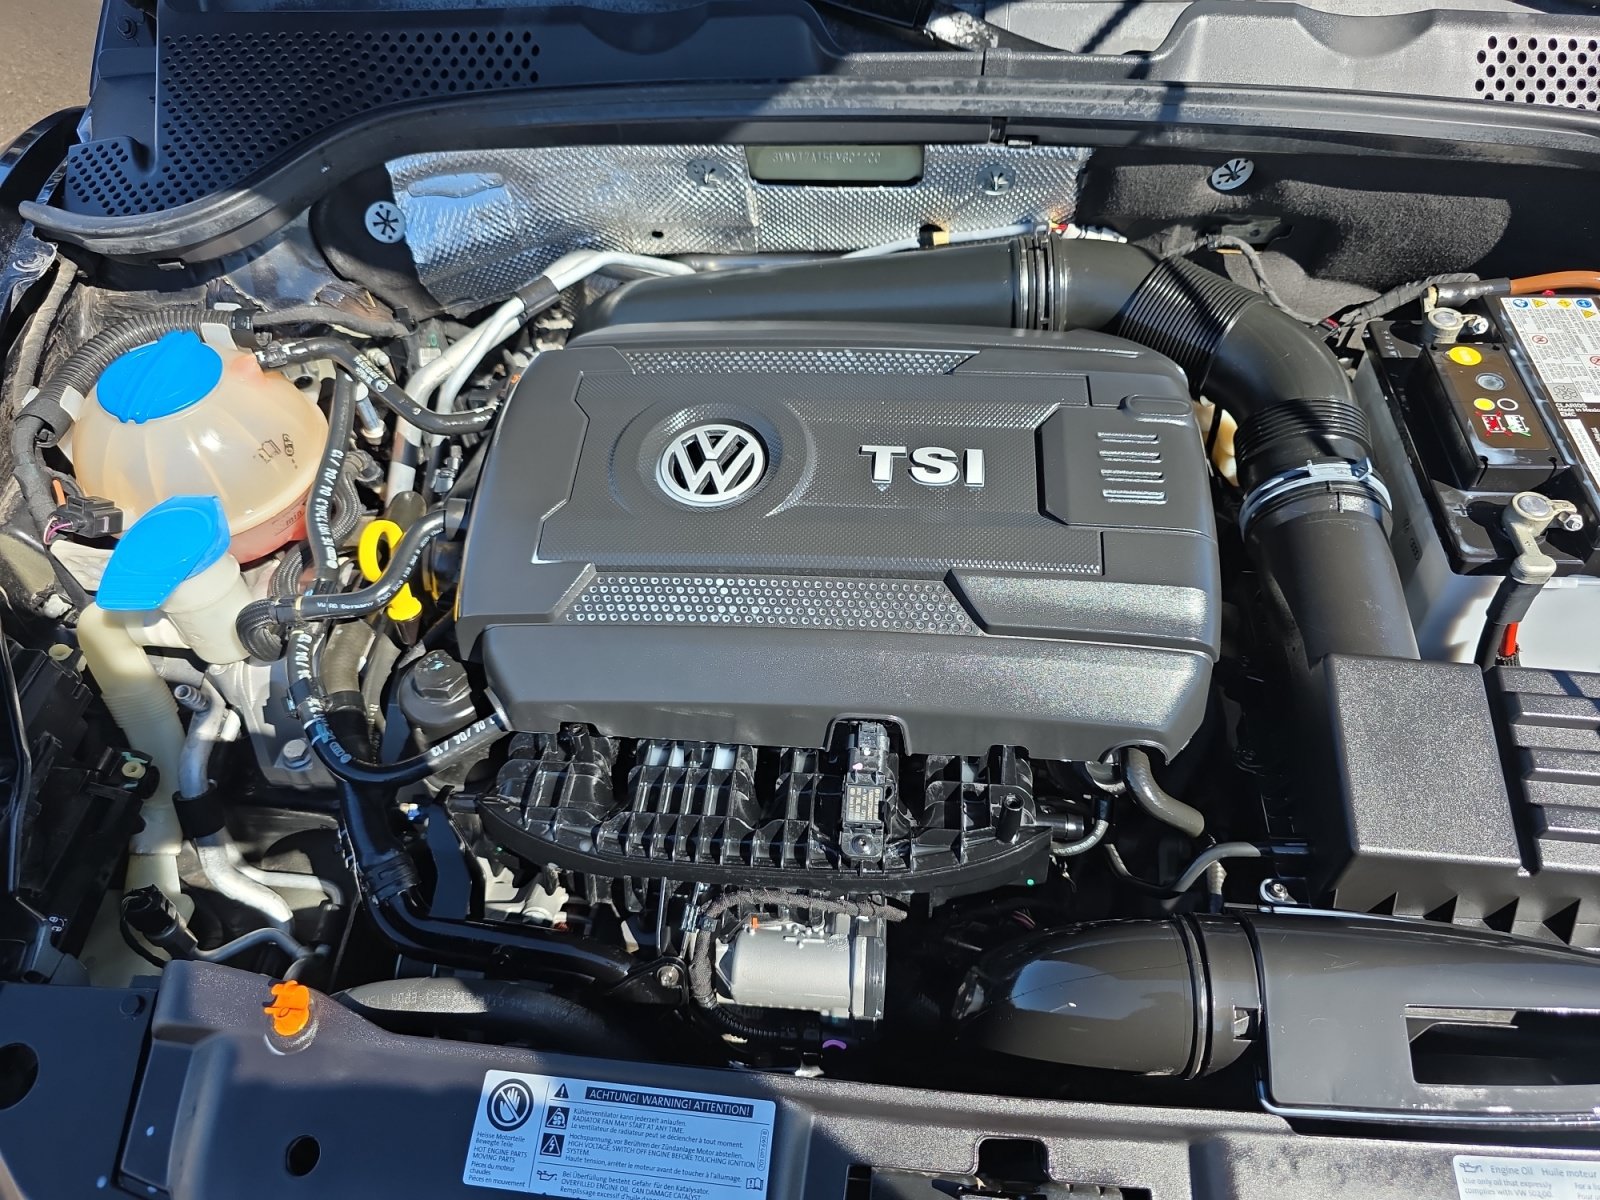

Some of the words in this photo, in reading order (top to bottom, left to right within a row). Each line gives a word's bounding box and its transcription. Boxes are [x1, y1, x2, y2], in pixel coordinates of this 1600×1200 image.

[859, 444, 985, 486] TSI
[590, 1089, 639, 1103] ACHTUNG!
[642, 1095, 692, 1109] WARNING!
[693, 1101, 750, 1116] ATTENTION!
[573, 1115, 601, 1123] RADIATOR
[574, 1108, 619, 1118] Kühlerventilator
[634, 1115, 659, 1124] jederzeit
[477, 1131, 494, 1139] Heisse
[496, 1133, 525, 1142] Motorteile
[578, 1124, 609, 1133] ventilateur
[717, 1140, 743, 1148] moment.
[476, 1138, 499, 1147] Bewegte
[624, 1140, 650, 1148] Berühren
[661, 1144, 696, 1154] Zündanlage
[696, 1148, 714, 1156] Motor
[612, 1146, 634, 1154] SWITCH
[648, 1150, 670, 1158] ENGINE
[695, 1155, 727, 1164] TOUCHING
[728, 1159, 755, 1168] IGNITION
[608, 1160, 627, 1168] arrêter
[1490, 1165, 1519, 1177] Engine
[1521, 1166, 1533, 1175] Oil
[1542, 1168, 1564, 1177] Huile
[1566, 1169, 1597, 1178] moteur
[493, 1179, 525, 1187] mouvement
[608, 1176, 630, 1185] besteht
[560, 1186, 595, 1197] Remplissage
[597, 1191, 620, 1199] excessif
[561, 1179, 595, 1188] OVERFILLED
[596, 1183, 620, 1191] ENGINE
[646, 1188, 674, 1197] DAMAGE
